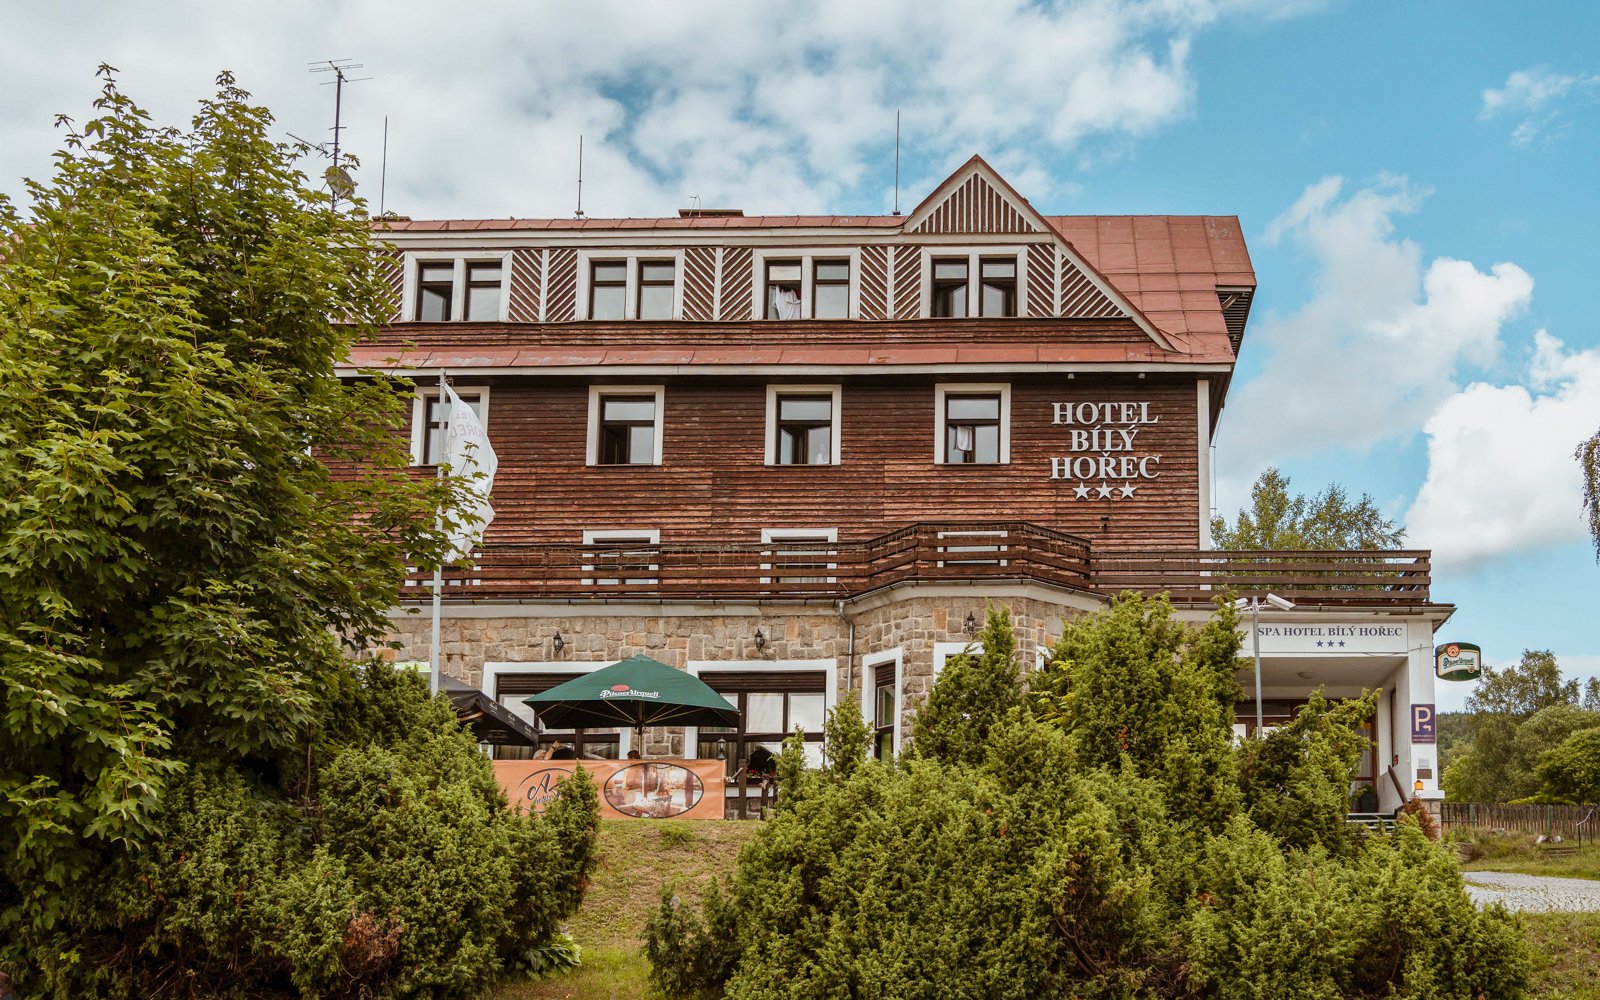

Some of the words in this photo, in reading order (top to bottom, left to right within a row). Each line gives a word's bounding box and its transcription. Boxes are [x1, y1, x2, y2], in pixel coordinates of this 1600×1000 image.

[1051, 402, 1159, 425] HOTEL
[1069, 424, 1139, 452] BÍLÝ
[1050, 452, 1160, 480] HOŘEC
[1258, 627, 1280, 637] SPA
[1284, 627, 1325, 637] HOTEL
[1328, 625, 1356, 637] BÍLÝ
[1359, 625, 1402, 637] HOŘEC
[1414, 706, 1431, 732] P
